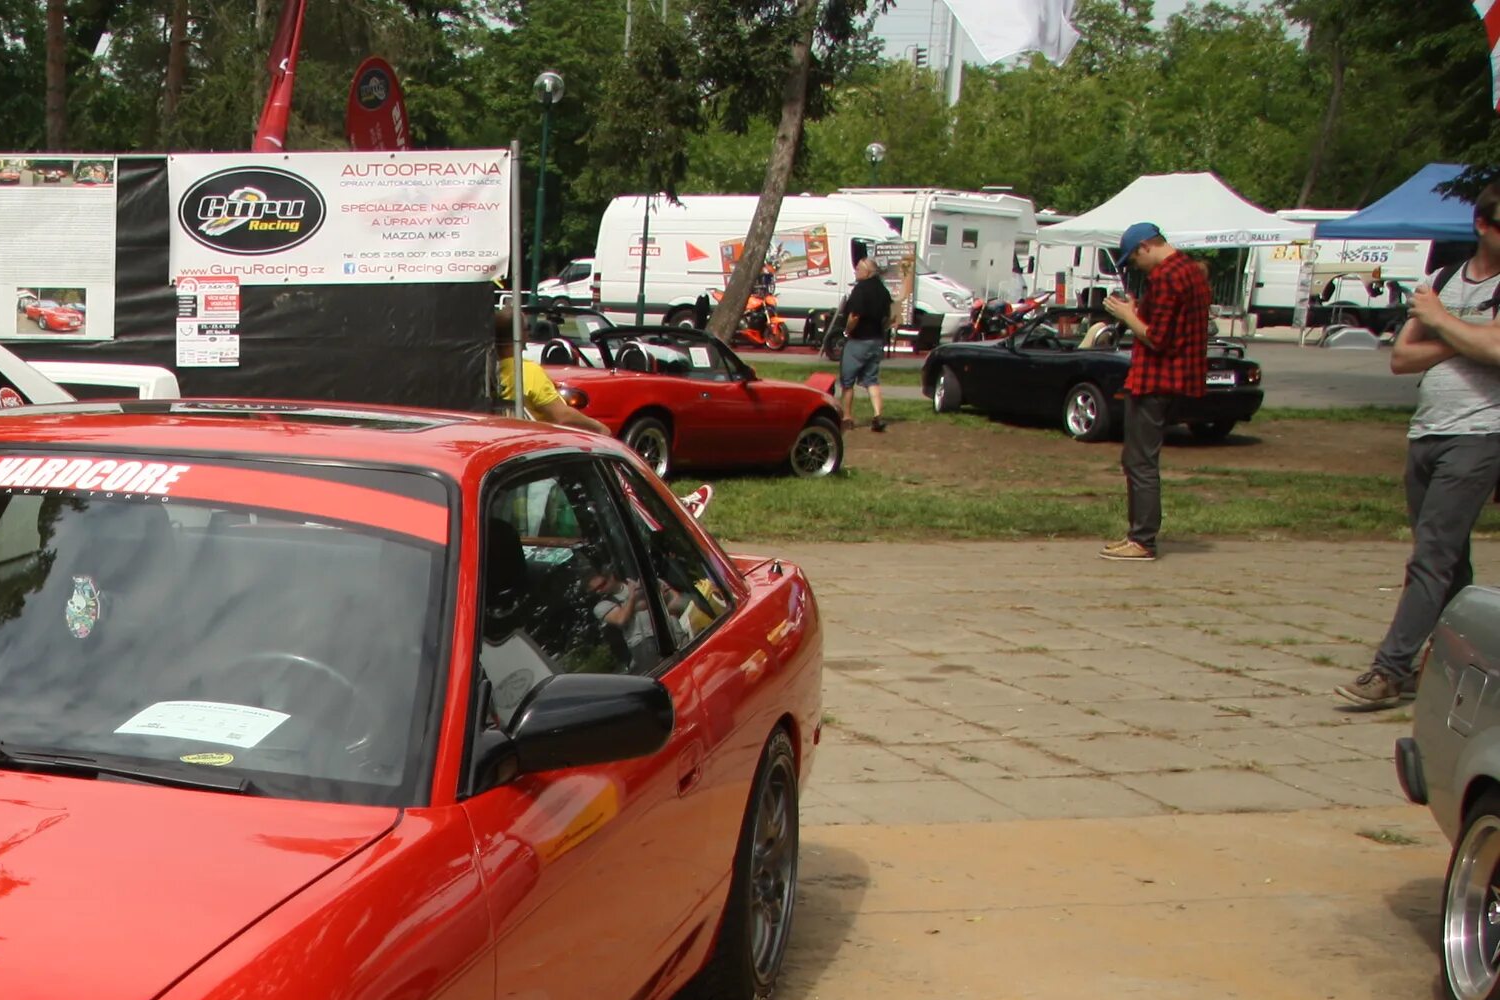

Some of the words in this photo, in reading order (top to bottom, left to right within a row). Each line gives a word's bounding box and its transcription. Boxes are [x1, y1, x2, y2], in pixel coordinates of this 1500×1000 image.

[341, 163, 501, 177] AUTOOPRAVNA
[435, 178, 465, 186] VŠECH
[467, 178, 501, 186] ZNAČEK
[198, 195, 305, 220] Guru
[341, 203, 427, 213] SPECIALIZACE
[431, 203, 448, 211] NA
[452, 202, 500, 211] OPRAVY
[371, 218, 380, 226] A
[384, 215, 432, 226] ÚPRAVY
[436, 215, 470, 225] VOZŮ
[248, 220, 300, 233] Racing
[382, 232, 425, 240] MAZDA
[429, 231, 460, 239] MX-5
[1251, 233, 1280, 241] RALLYE
[1361, 251, 1388, 262] 555
[180, 264, 325, 276] www.GuruRacing.cz
[358, 264, 394, 274] Guru
[398, 263, 443, 275] Racing
[447, 262, 497, 275] Garage
